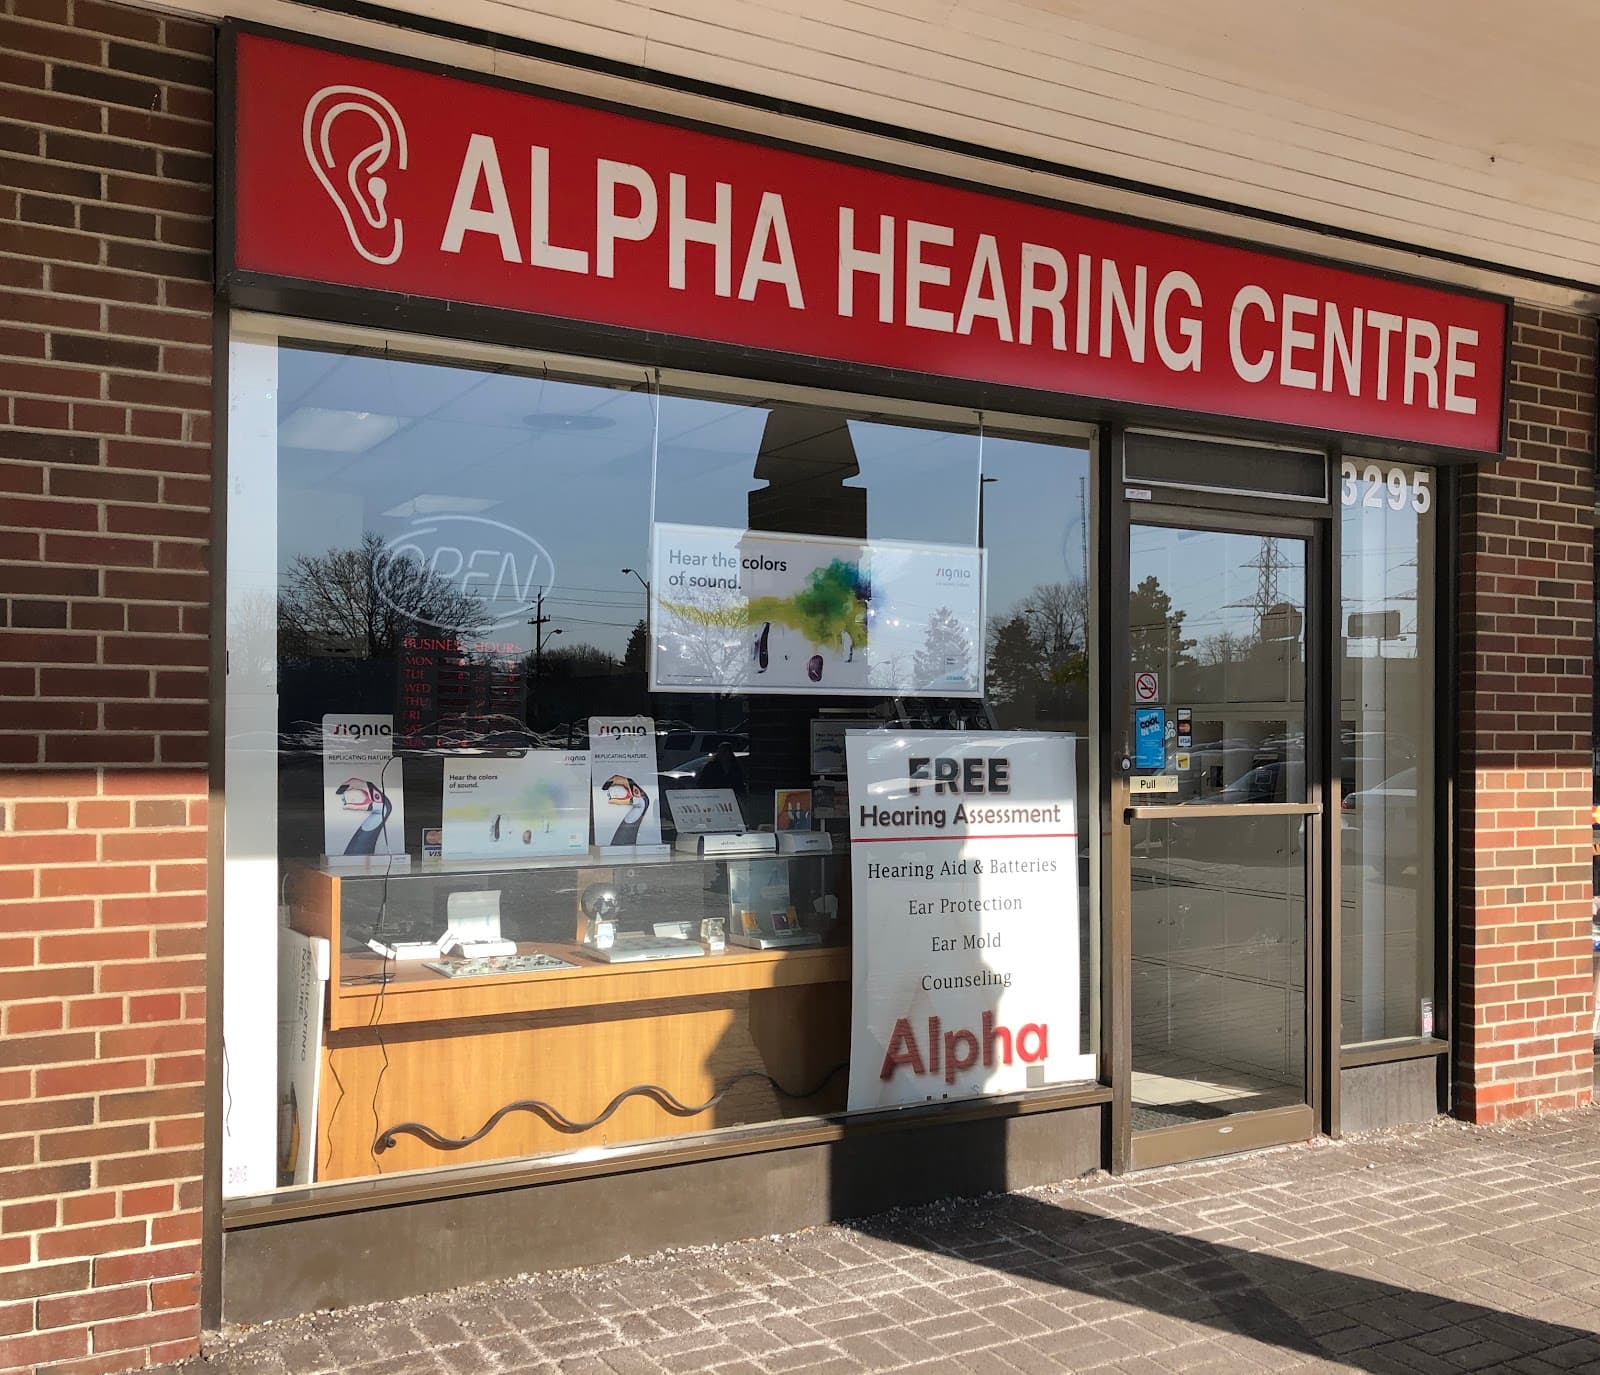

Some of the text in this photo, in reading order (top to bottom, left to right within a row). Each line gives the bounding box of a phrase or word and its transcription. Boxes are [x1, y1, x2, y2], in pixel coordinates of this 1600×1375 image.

[440, 133, 1479, 415] ALPHA HEARING CENTRE
[1341, 461, 1431, 514] 3295
[668, 549, 788, 573] Hear the colors
[386, 543, 539, 604] OPEN
[668, 573, 742, 590] of sound.
[935, 567, 971, 581] signia
[333, 724, 392, 740] signia
[598, 725, 647, 741] signia
[1140, 716, 1160, 729] COOL
[449, 774, 465, 782] Hear
[908, 757, 1012, 796] FREE
[1140, 779, 1156, 789] Pull
[859, 802, 1061, 828] Hearing Assessment
[867, 858, 1058, 880] Hearing Aid & Batteries
[908, 895, 1023, 915] Ear Protection
[931, 932, 1003, 952] Ear Mold
[921, 969, 1013, 991] Counseling
[879, 1009, 1049, 1085] Alpha
